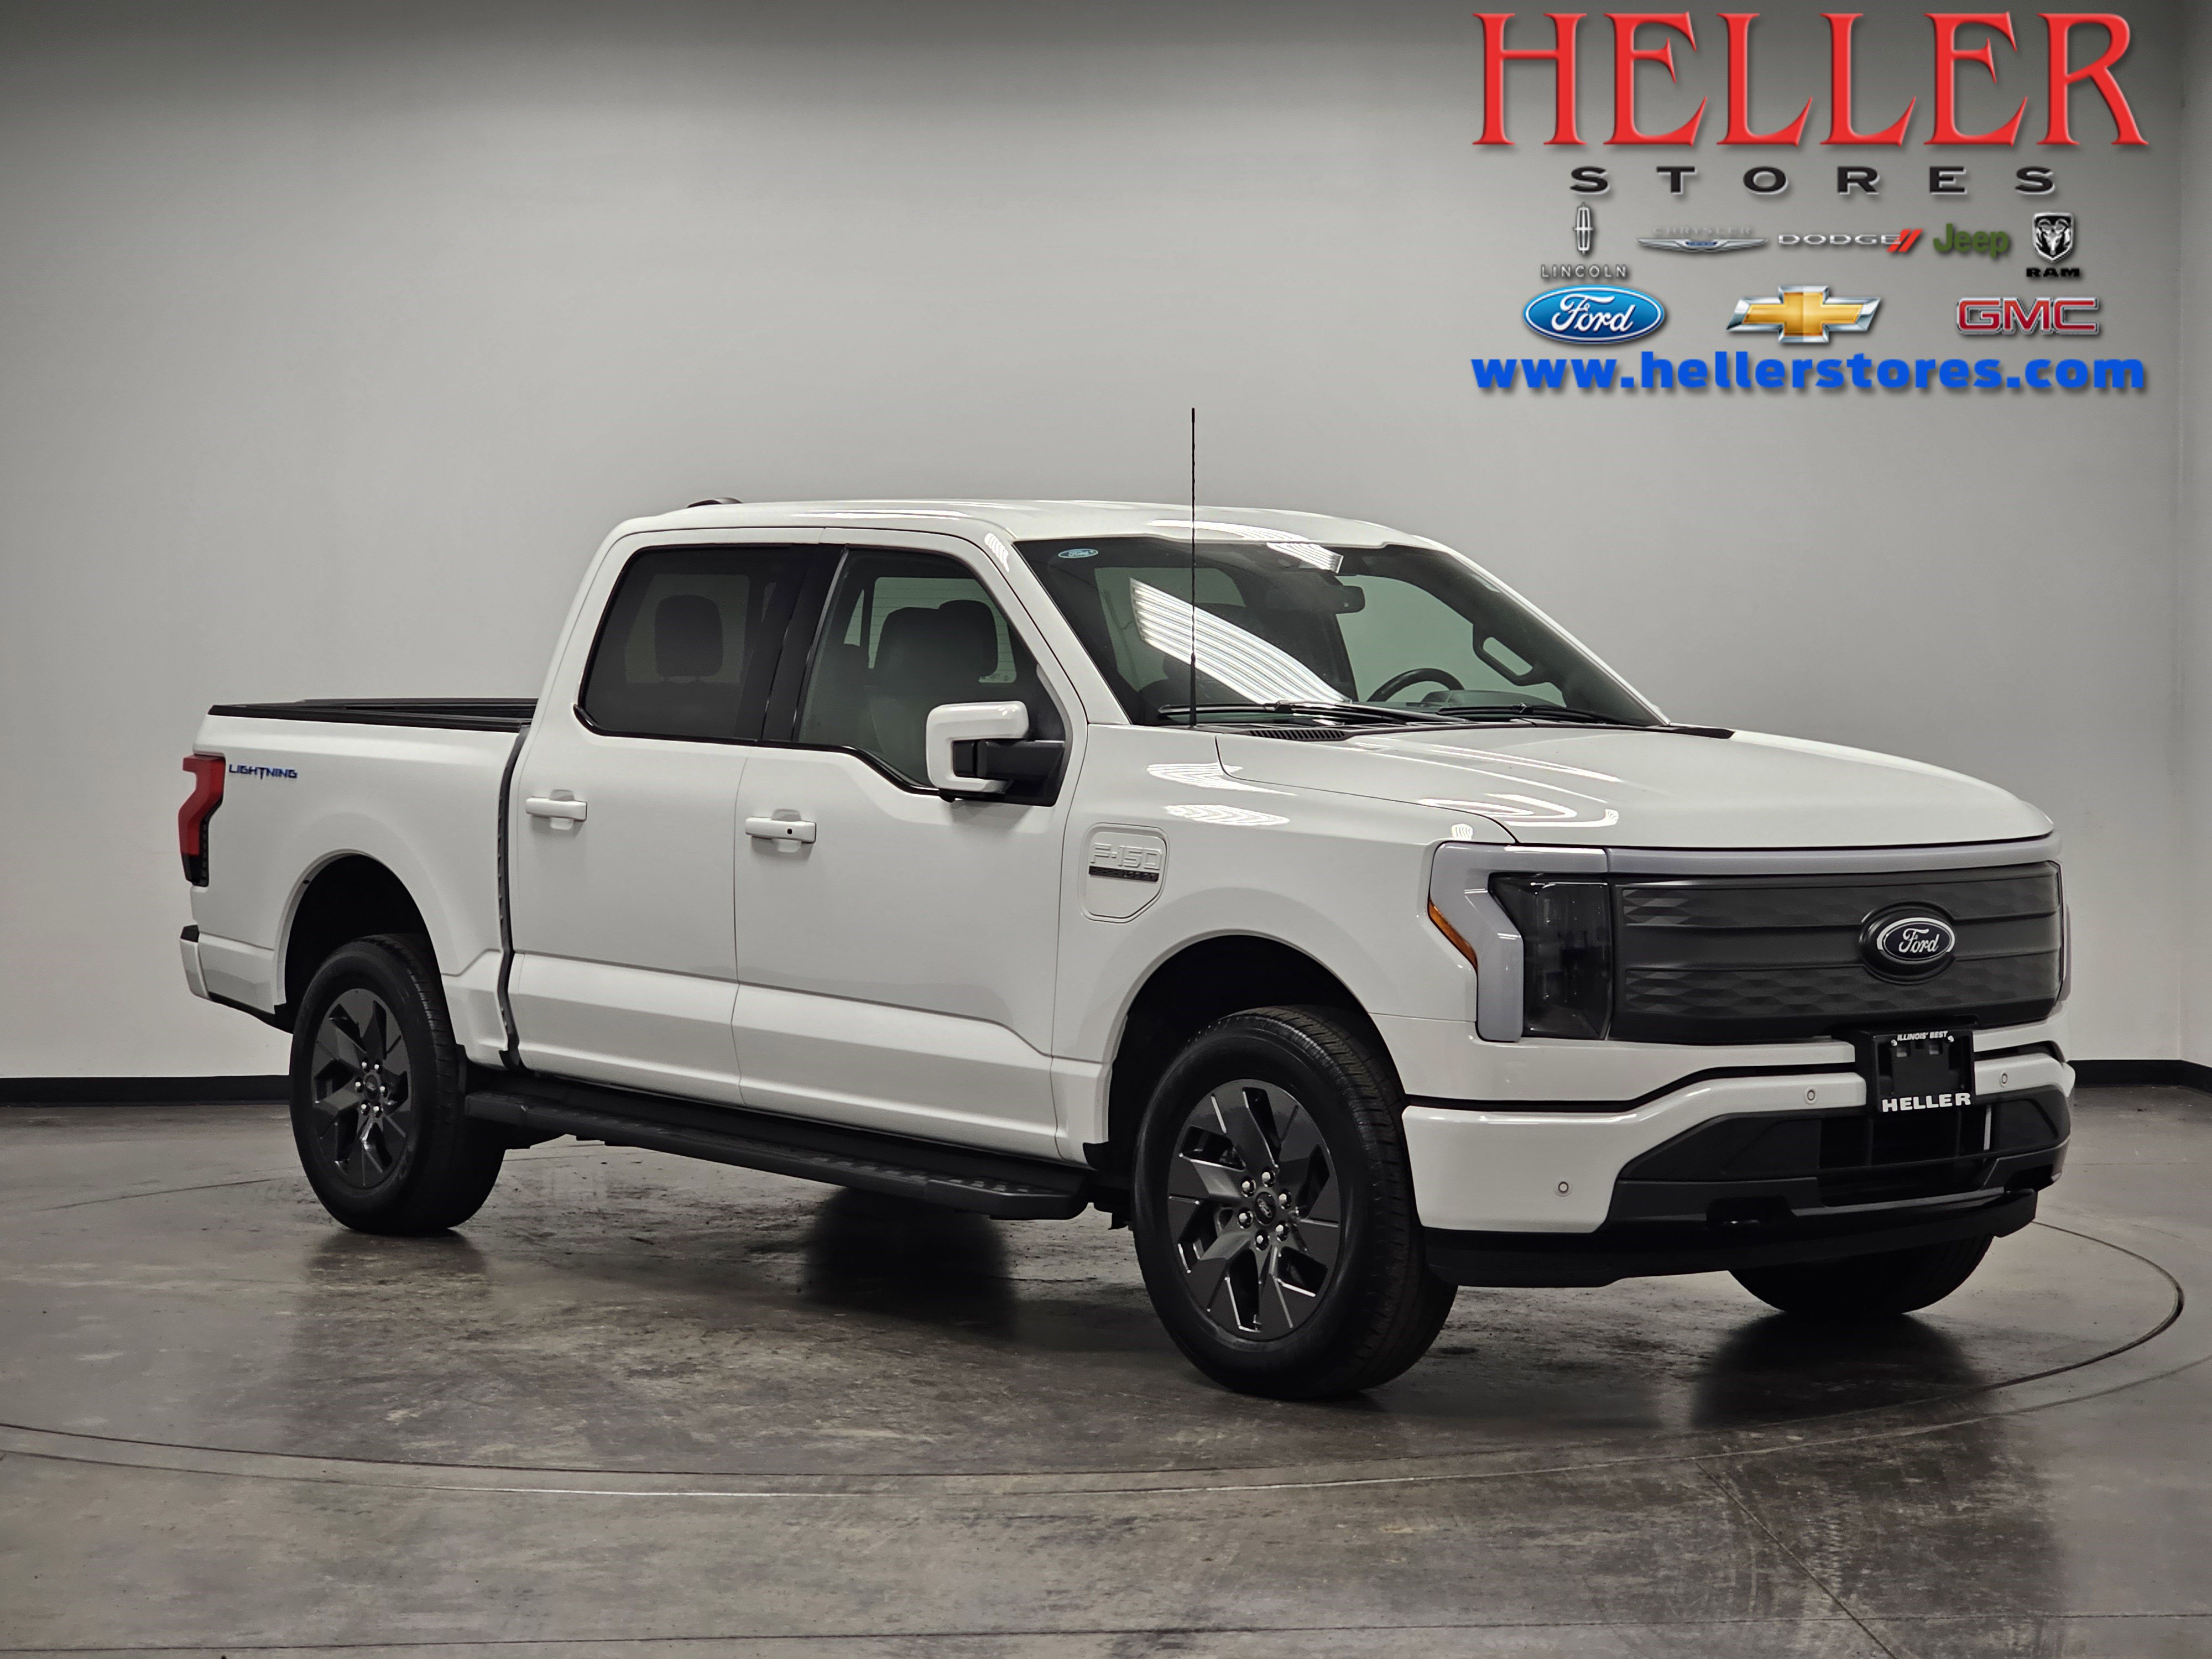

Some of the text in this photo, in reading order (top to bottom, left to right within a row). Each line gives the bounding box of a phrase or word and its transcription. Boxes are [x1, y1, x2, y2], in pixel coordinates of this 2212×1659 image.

[228, 764, 298, 779] LIGHTNING
[1090, 843, 1163, 870] F-150
[1898, 928, 1940, 953] Ford
[1929, 1030, 1949, 1039] BEST
[1882, 1092, 1971, 1113] HELLER
